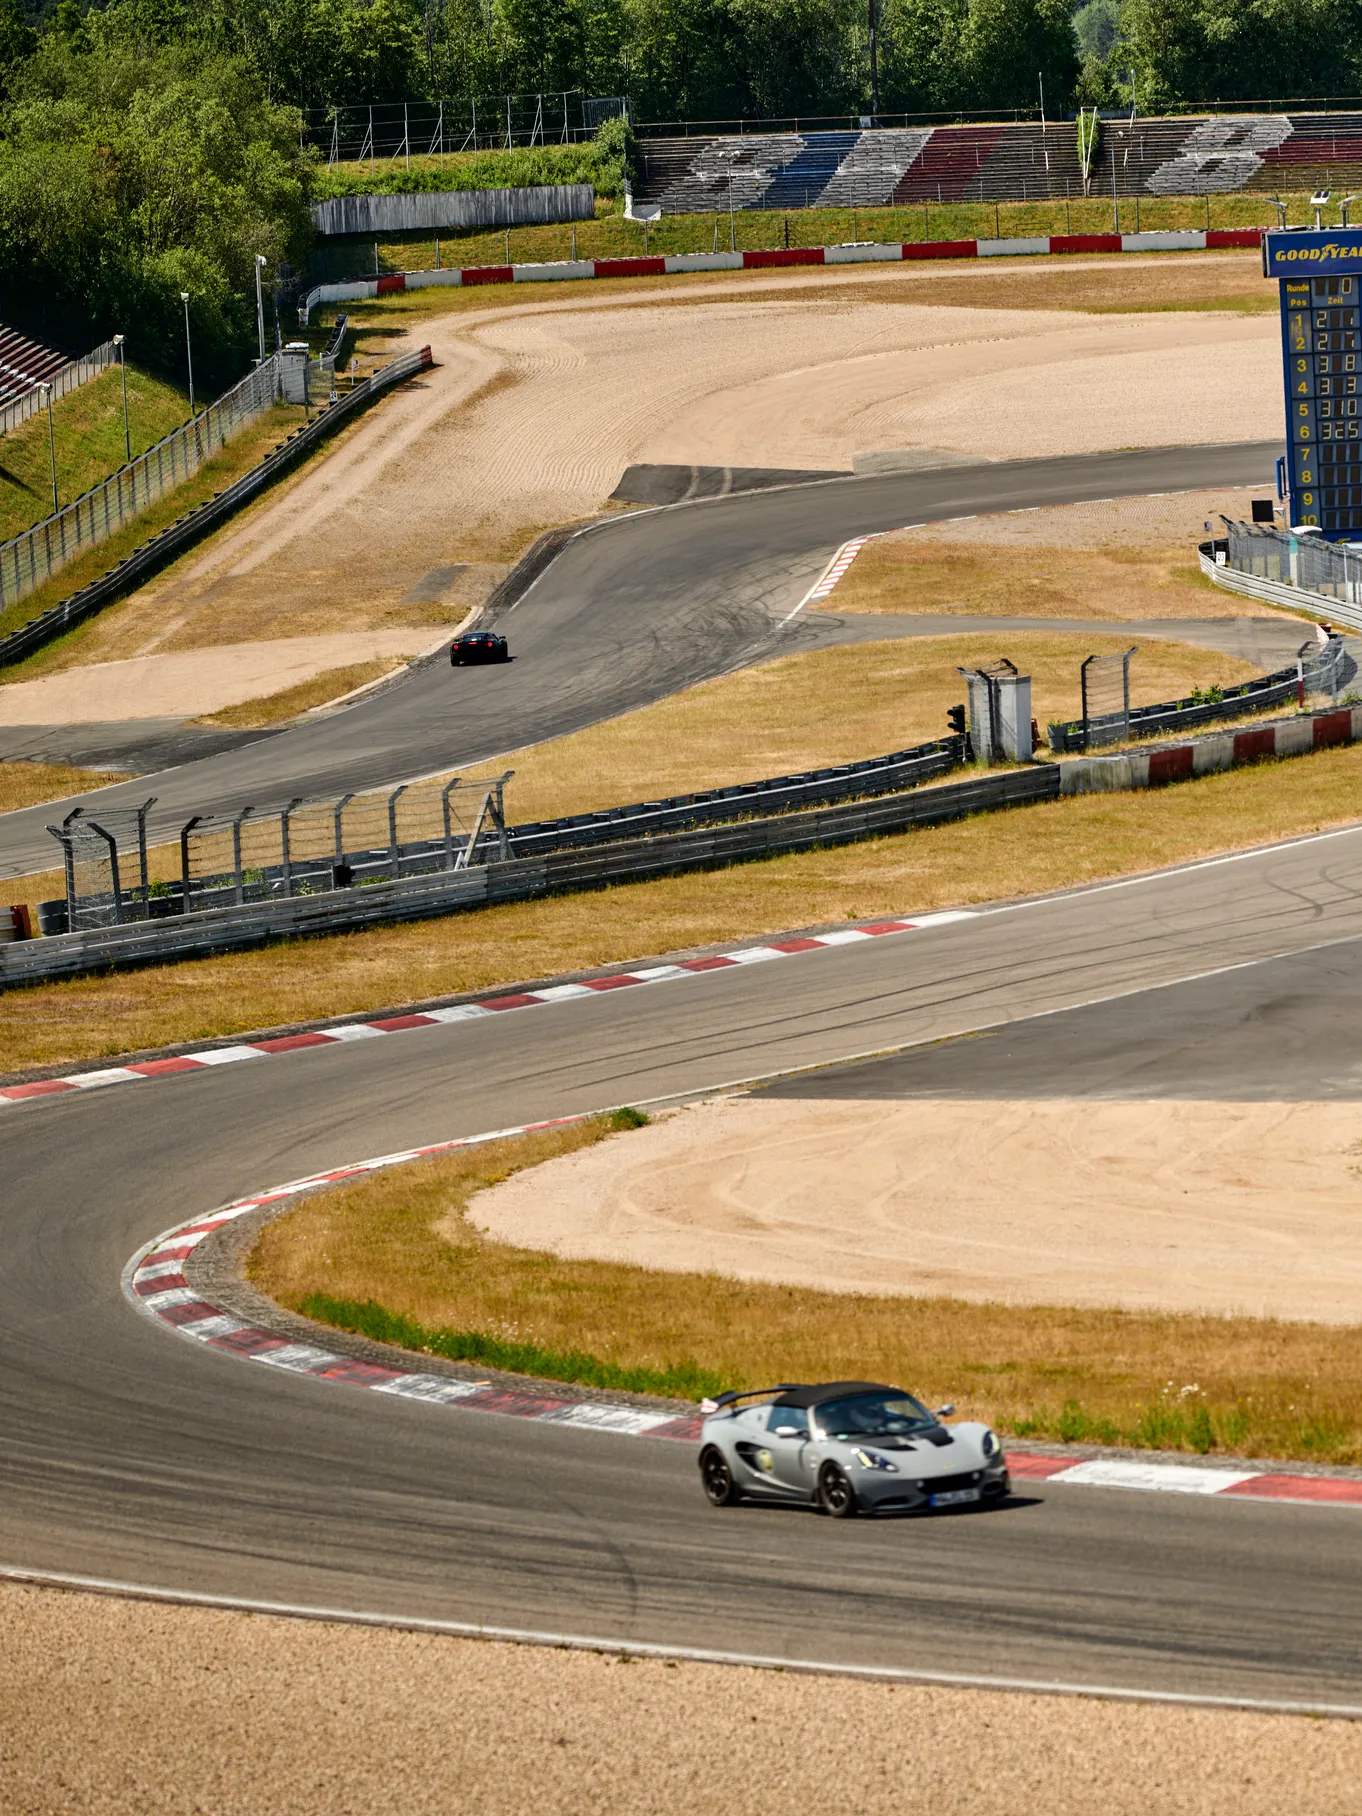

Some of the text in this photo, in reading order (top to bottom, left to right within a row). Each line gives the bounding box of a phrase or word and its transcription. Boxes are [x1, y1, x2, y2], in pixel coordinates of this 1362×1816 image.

[1286, 284, 1309, 293] Runde
[1290, 296, 1344, 307] Pos Zeit
[1295, 314, 1302, 327] 1
[1296, 337, 1305, 350] 2
[1297, 359, 1307, 373] 3
[1297, 382, 1308, 394] 4
[1299, 403, 1309, 417] 5
[1300, 425, 1310, 439] 6
[1301, 448, 1311, 461] 7
[1302, 470, 1312, 483] 8
[1303, 492, 1313, 506] 9
[1301, 514, 1317, 527] 10
